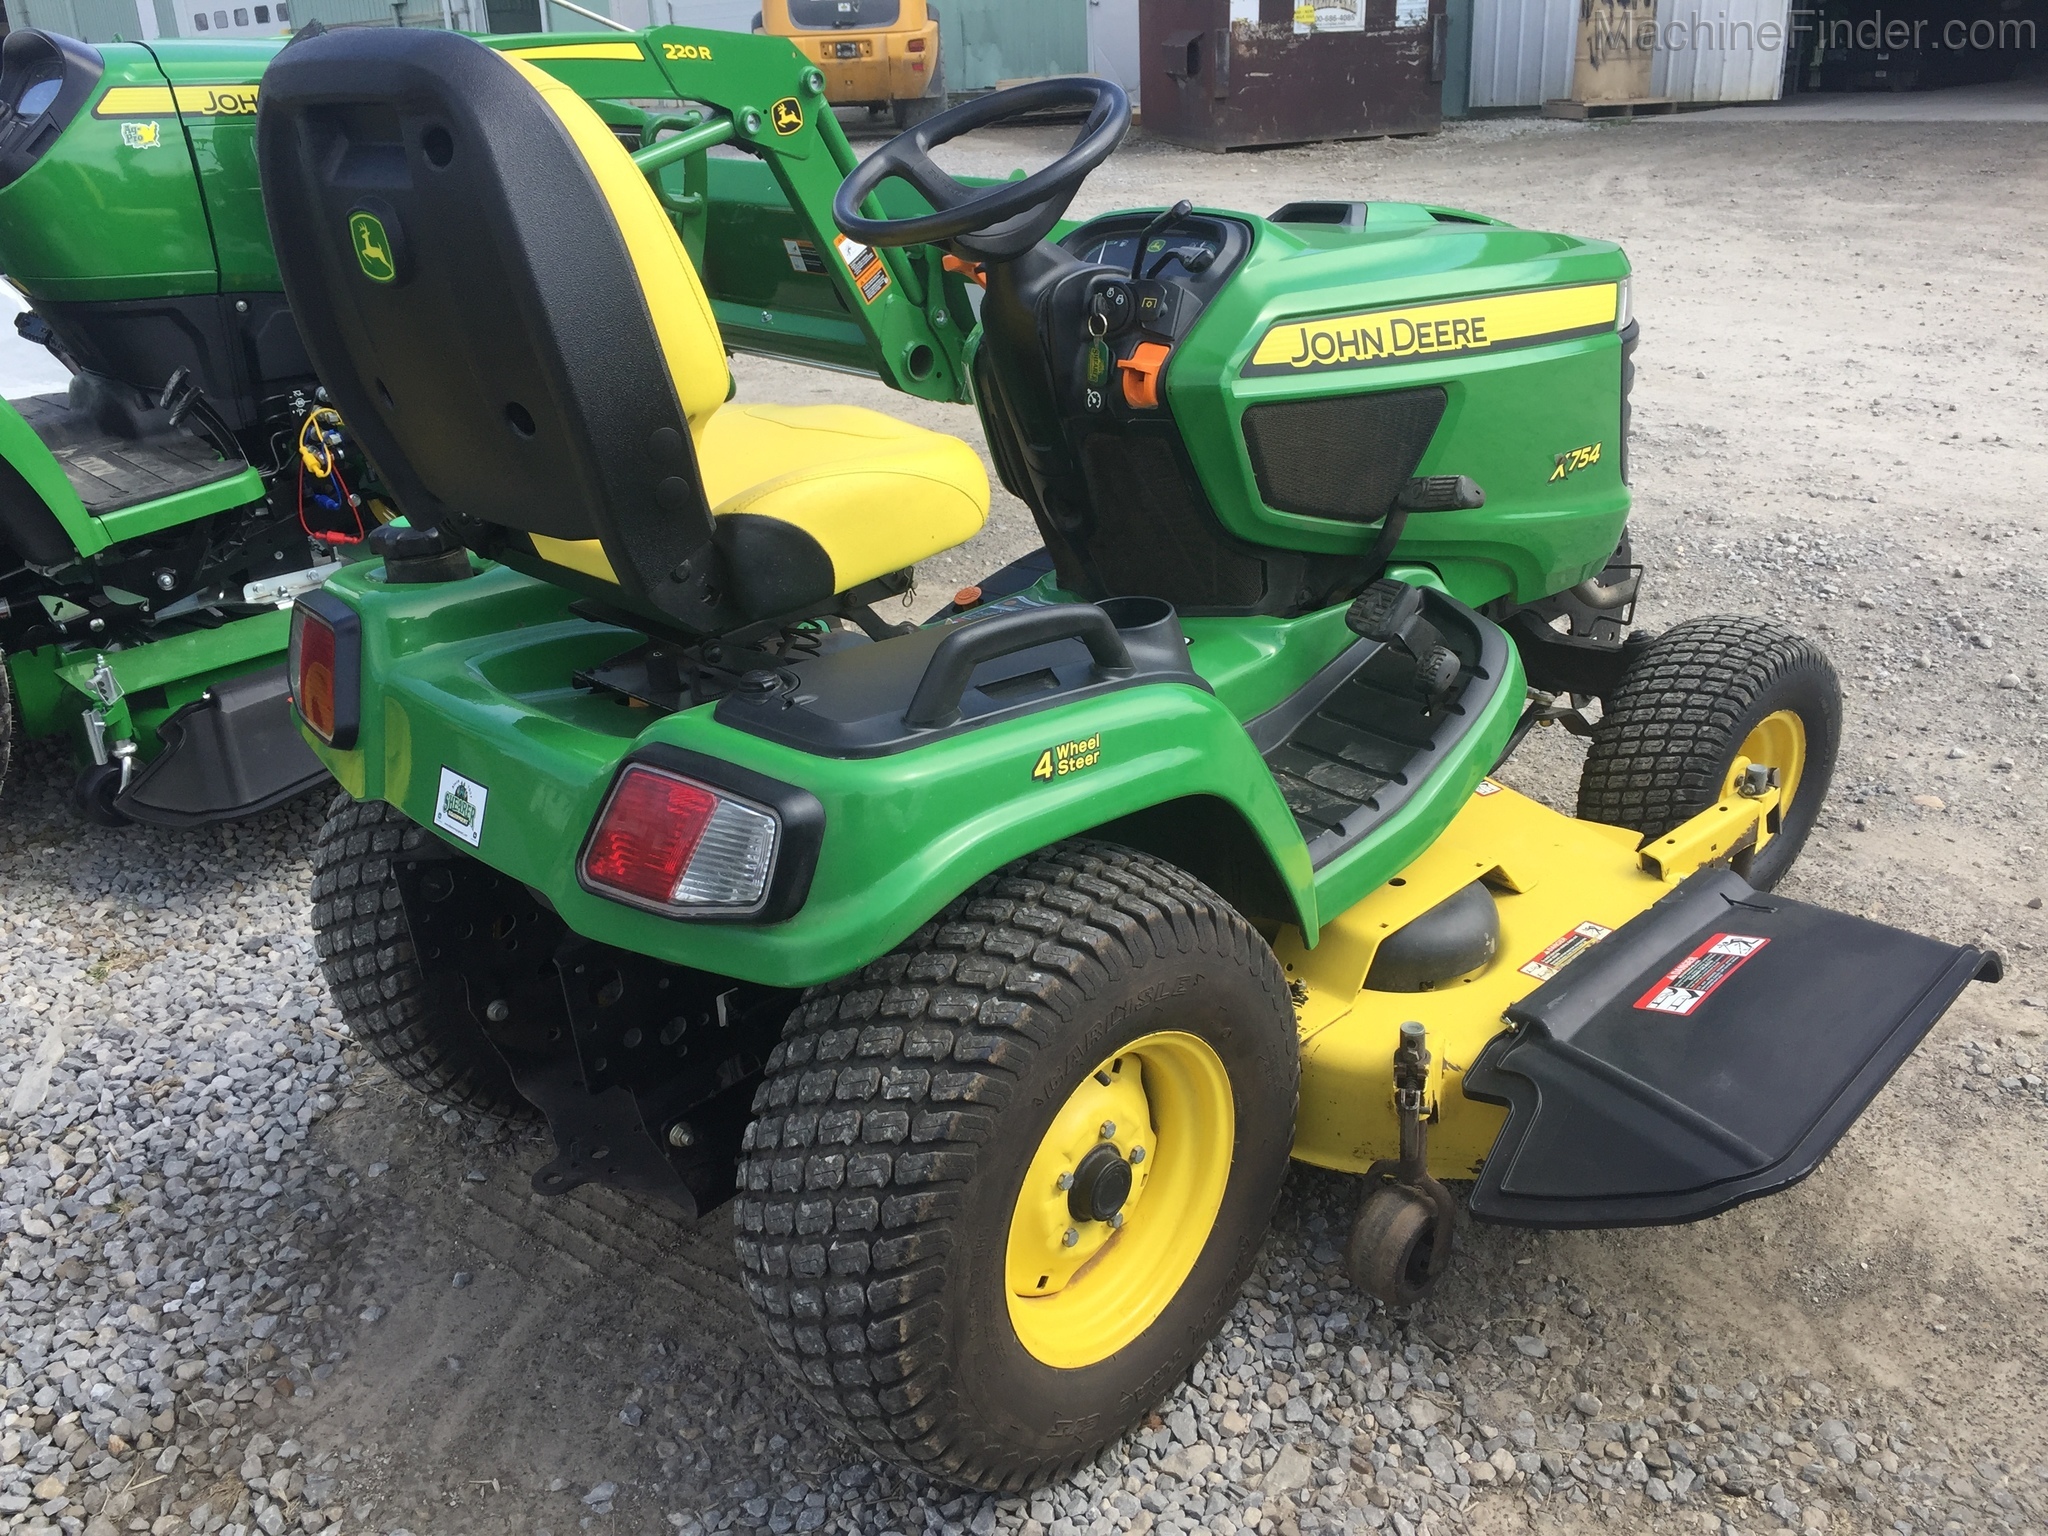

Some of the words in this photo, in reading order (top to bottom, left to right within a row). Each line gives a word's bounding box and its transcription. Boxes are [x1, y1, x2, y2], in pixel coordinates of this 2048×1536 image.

[1291, 327, 1384, 363] JOHN
[1390, 317, 1488, 352] DEERE
[1548, 441, 1602, 482] X754
[1032, 748, 1054, 780] 4
[1056, 732, 1100, 760] Wheel
[1057, 750, 1100, 776] Steer
